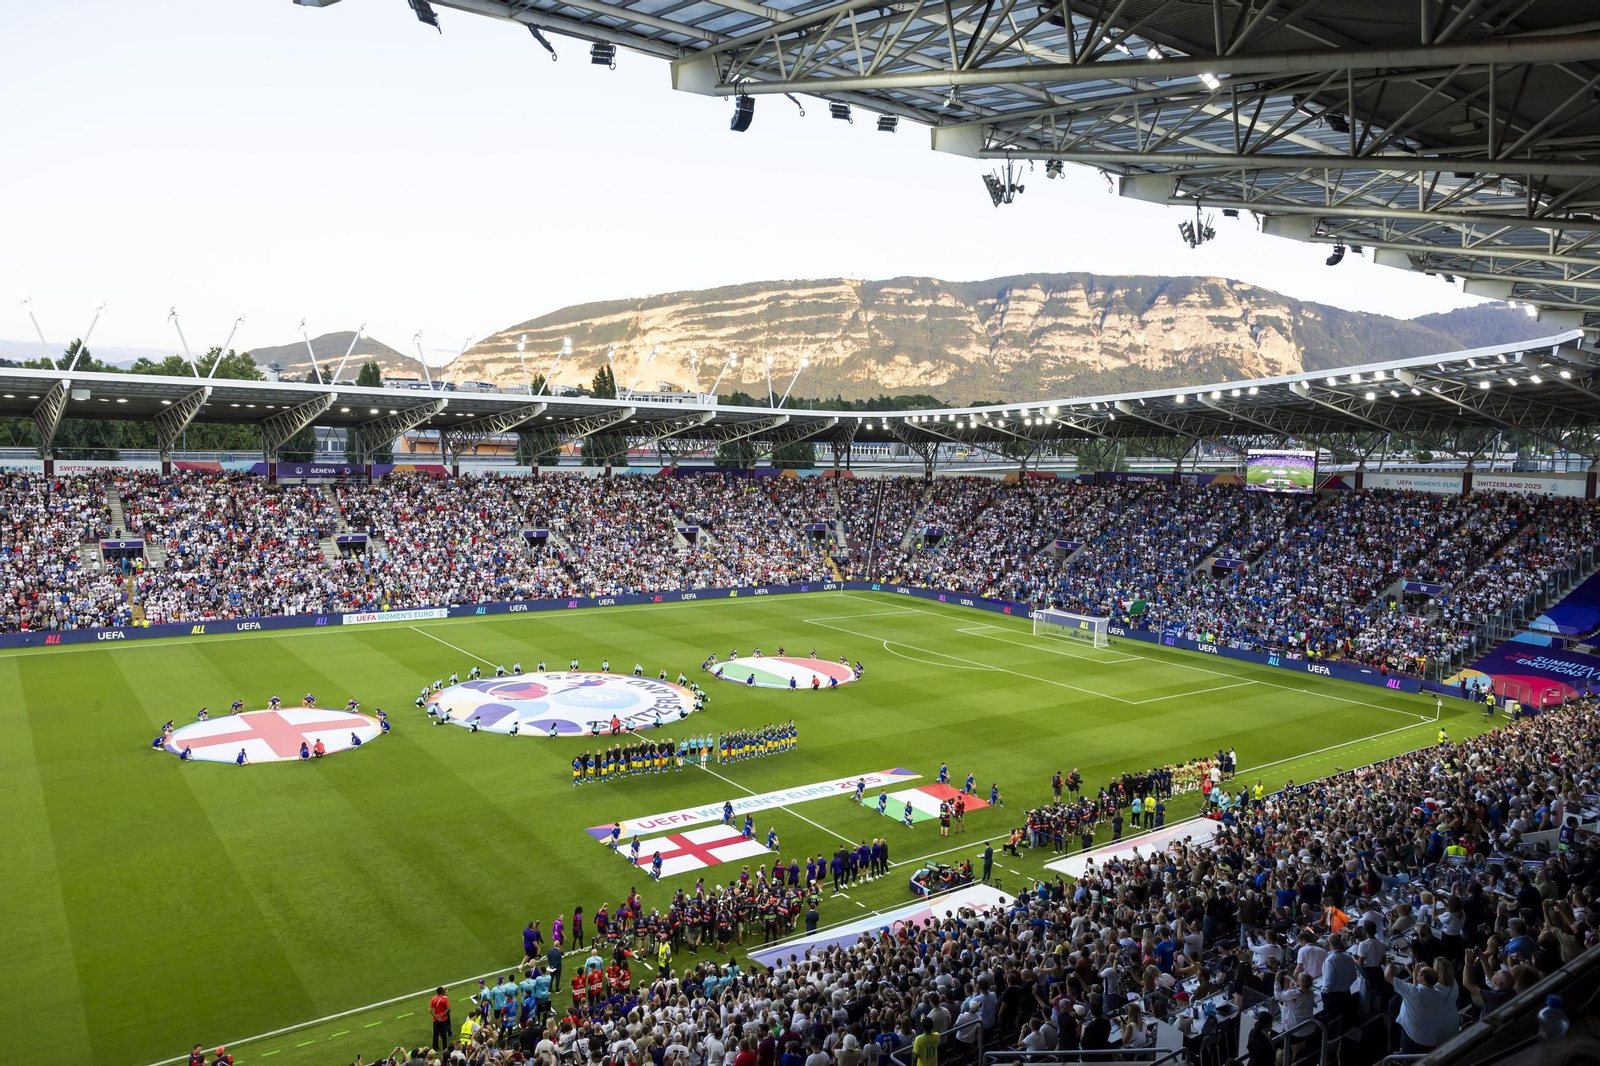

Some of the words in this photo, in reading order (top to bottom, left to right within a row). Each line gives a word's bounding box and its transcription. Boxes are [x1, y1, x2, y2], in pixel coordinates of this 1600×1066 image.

[1413, 480, 1441, 488] WOMEN'S
[568, 600, 578, 608] ALL
[960, 599, 974, 607] UEFA
[475, 606, 487, 615] ALL
[509, 604, 528, 612] UEFA
[1003, 606, 1011, 614] ALL
[356, 614, 376, 622] UEFA
[378, 611, 412, 620] WOMEN'S
[414, 610, 434, 618] EURO
[315, 617, 328, 625] ALL
[1080, 621, 1089, 630] ALL
[191, 625, 205, 634] ALL
[237, 622, 261, 631] UEFA
[97, 631, 125, 640] UEFA
[1108, 627, 1125, 636] UEFA
[45, 634, 61, 644] ALL
[1164, 637, 1175, 646] ALL
[1198, 643, 1218, 654] UEFA
[1268, 656, 1280, 666] ALL
[1515, 652, 1536, 660] THE
[1534, 656, 1589, 670] SUMMIT
[1307, 664, 1330, 675] UEFA
[1516, 658, 1586, 677] EMOTIONS
[1386, 678, 1400, 690] ALL
[586, 680, 681, 729] SITZERLAND
[637, 813, 698, 830] UEFA
[786, 785, 835, 799] EURO
[835, 776, 881, 789] 205
[926, 1044, 935, 1060] 10
